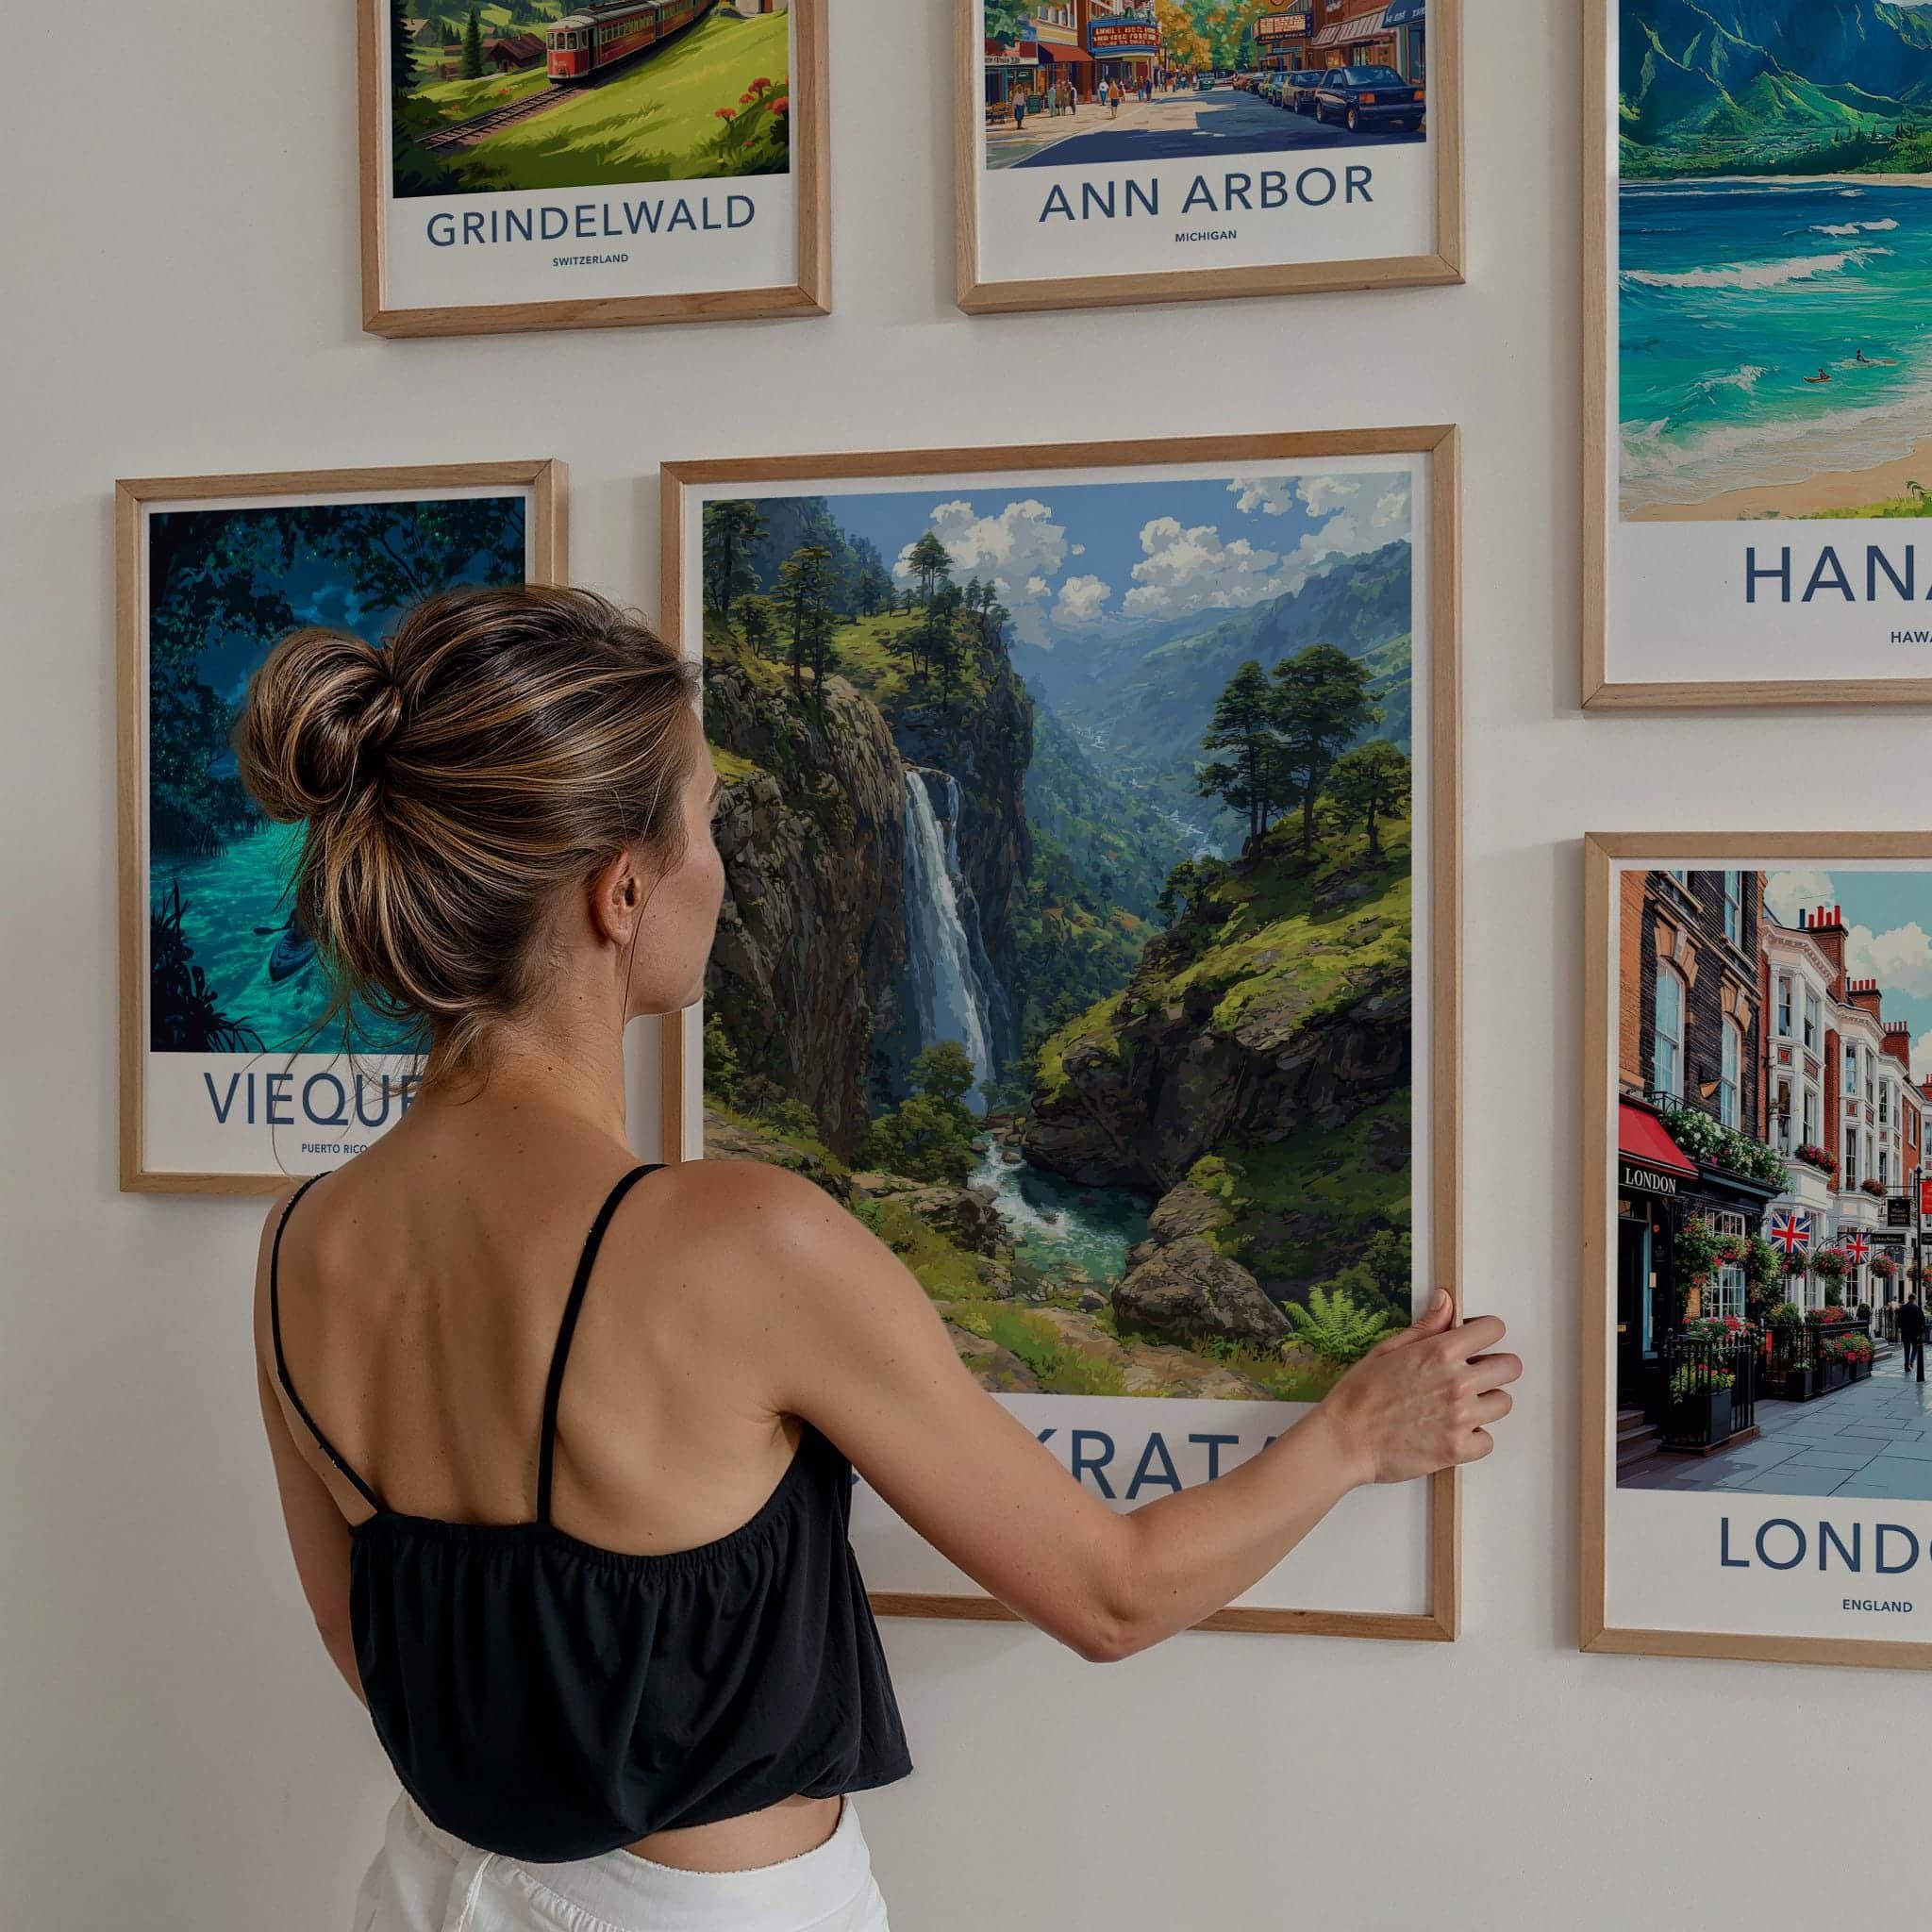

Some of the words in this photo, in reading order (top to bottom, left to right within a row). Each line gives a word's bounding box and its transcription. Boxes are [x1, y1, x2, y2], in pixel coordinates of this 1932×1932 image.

[1039, 177, 1158, 223] ANN
[1182, 165, 1374, 214] ARBOR
[426, 194, 756, 247] GRINDELWALD
[1174, 229, 1238, 242] MICHIGAN
[552, 254, 629, 267] SWITZERLAND
[1746, 544, 1932, 603] HAN
[1890, 631, 1932, 643] HAW
[301, 1143, 341, 1154] PUERTO
[343, 1144, 367, 1155] RICO
[1624, 1167, 1676, 1194] LONDON
[1035, 1428, 1279, 1500] RAT
[1721, 1517, 1932, 1574] LOND
[1842, 1599, 1913, 1613] ENGLAND
